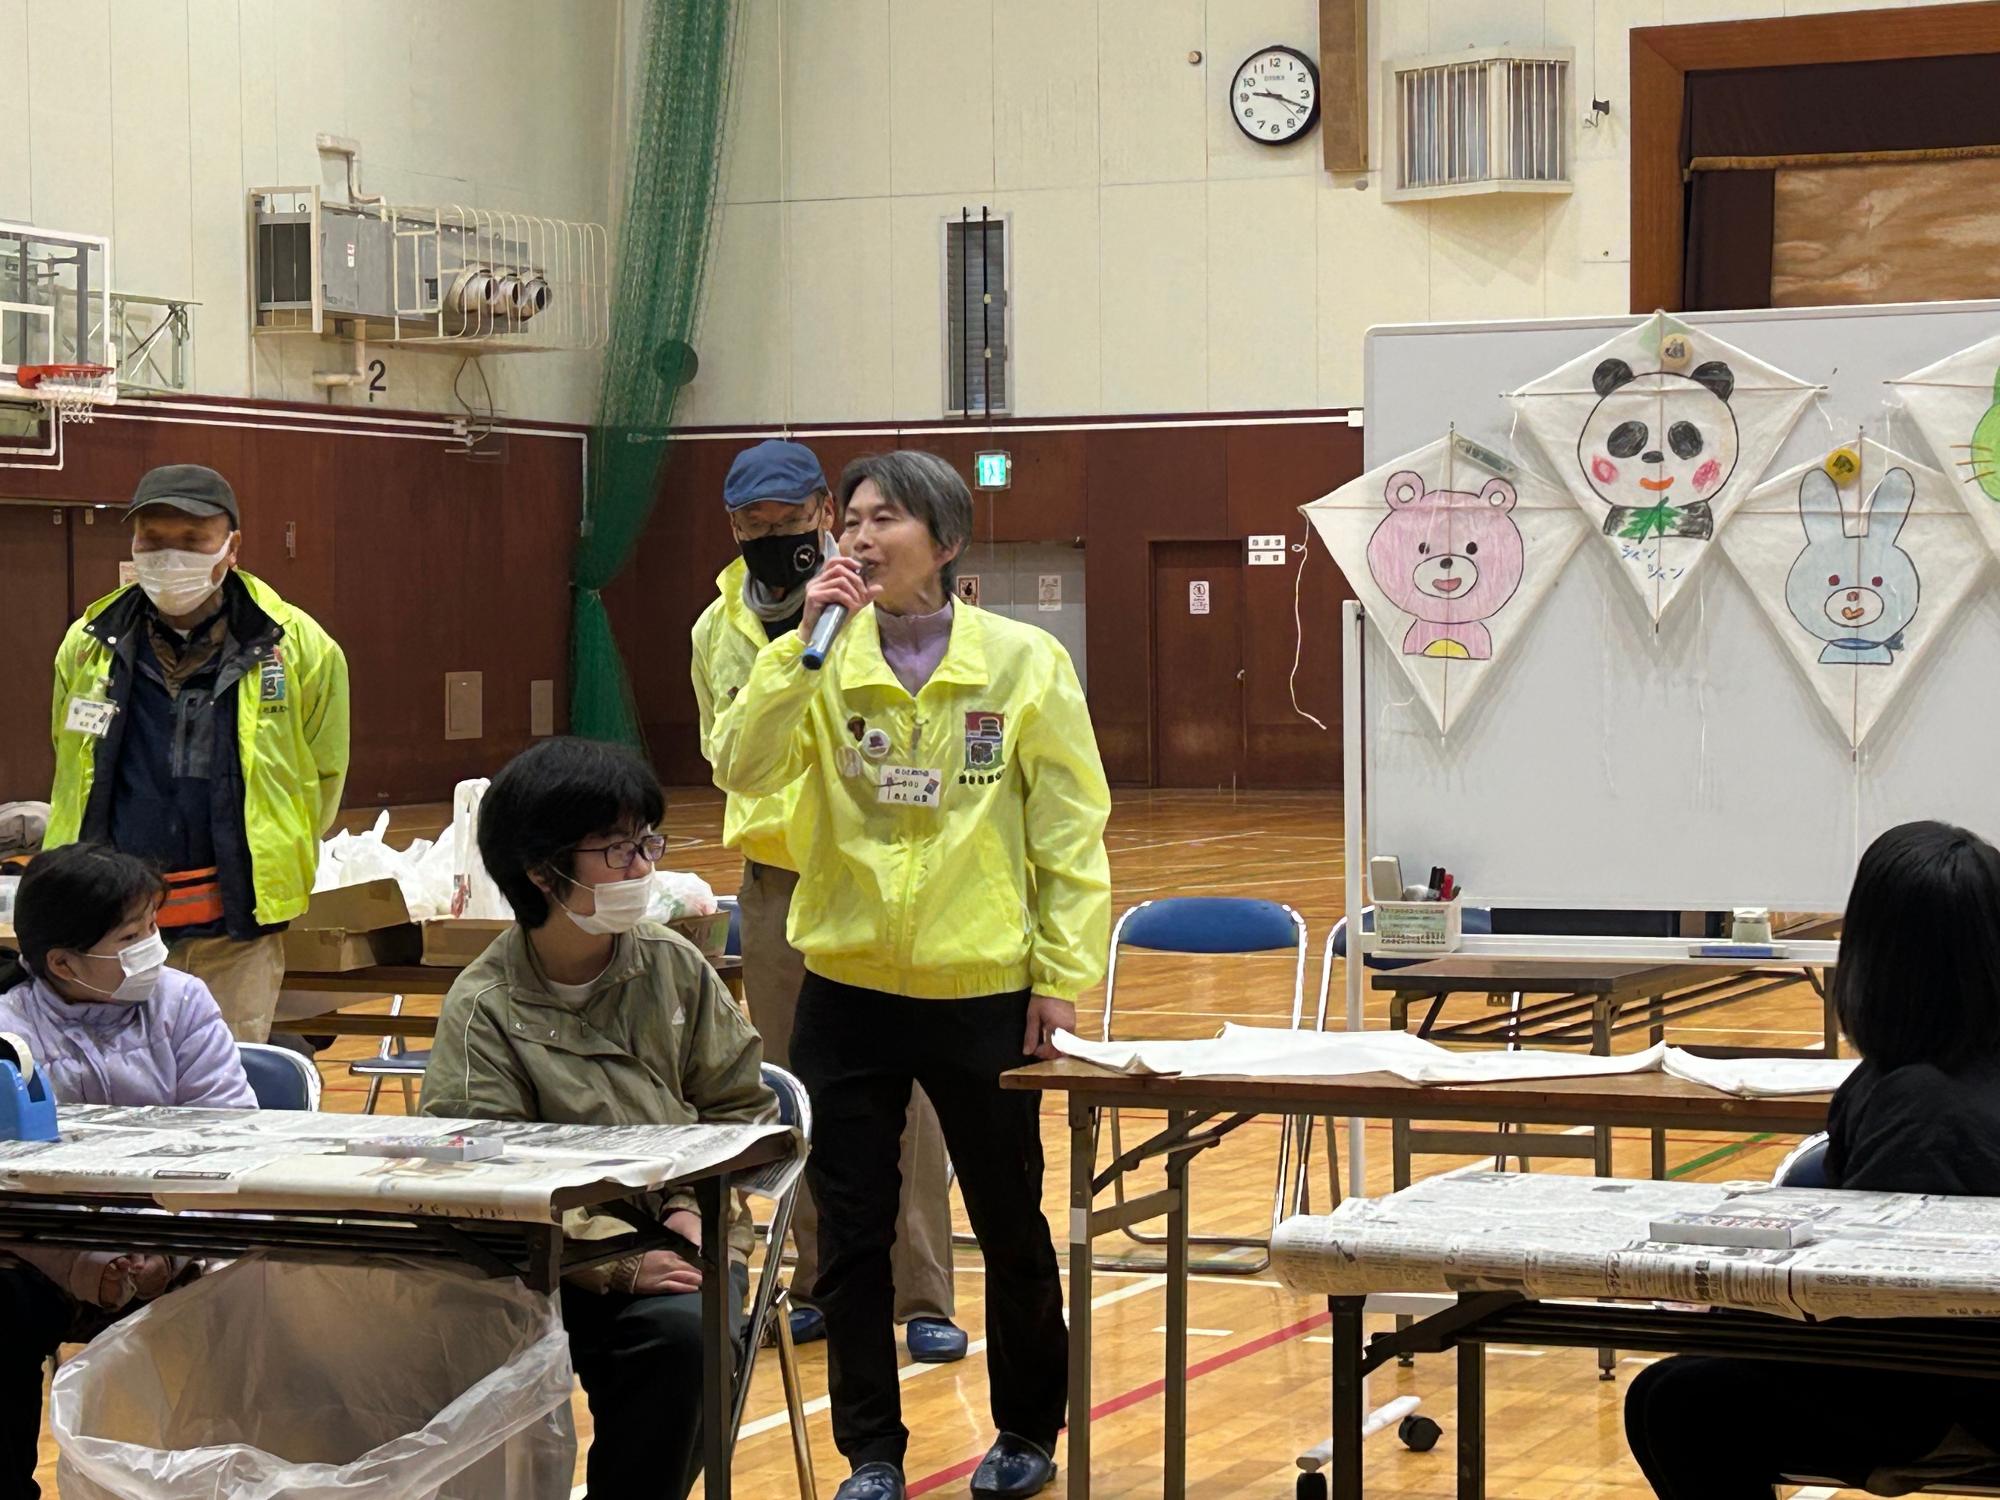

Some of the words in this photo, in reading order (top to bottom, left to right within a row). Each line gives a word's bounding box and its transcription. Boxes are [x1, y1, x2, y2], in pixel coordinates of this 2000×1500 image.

[1270, 58, 1280, 67] 12
[1289, 61, 1293, 71] 1
[1254, 64, 1264, 74] 11
[1243, 77, 1256, 87] 10
[1297, 72, 1306, 83] 2
[1300, 89, 1310, 99] 3
[1257, 120, 1265, 130] 7
[368, 359, 387, 391] 2
